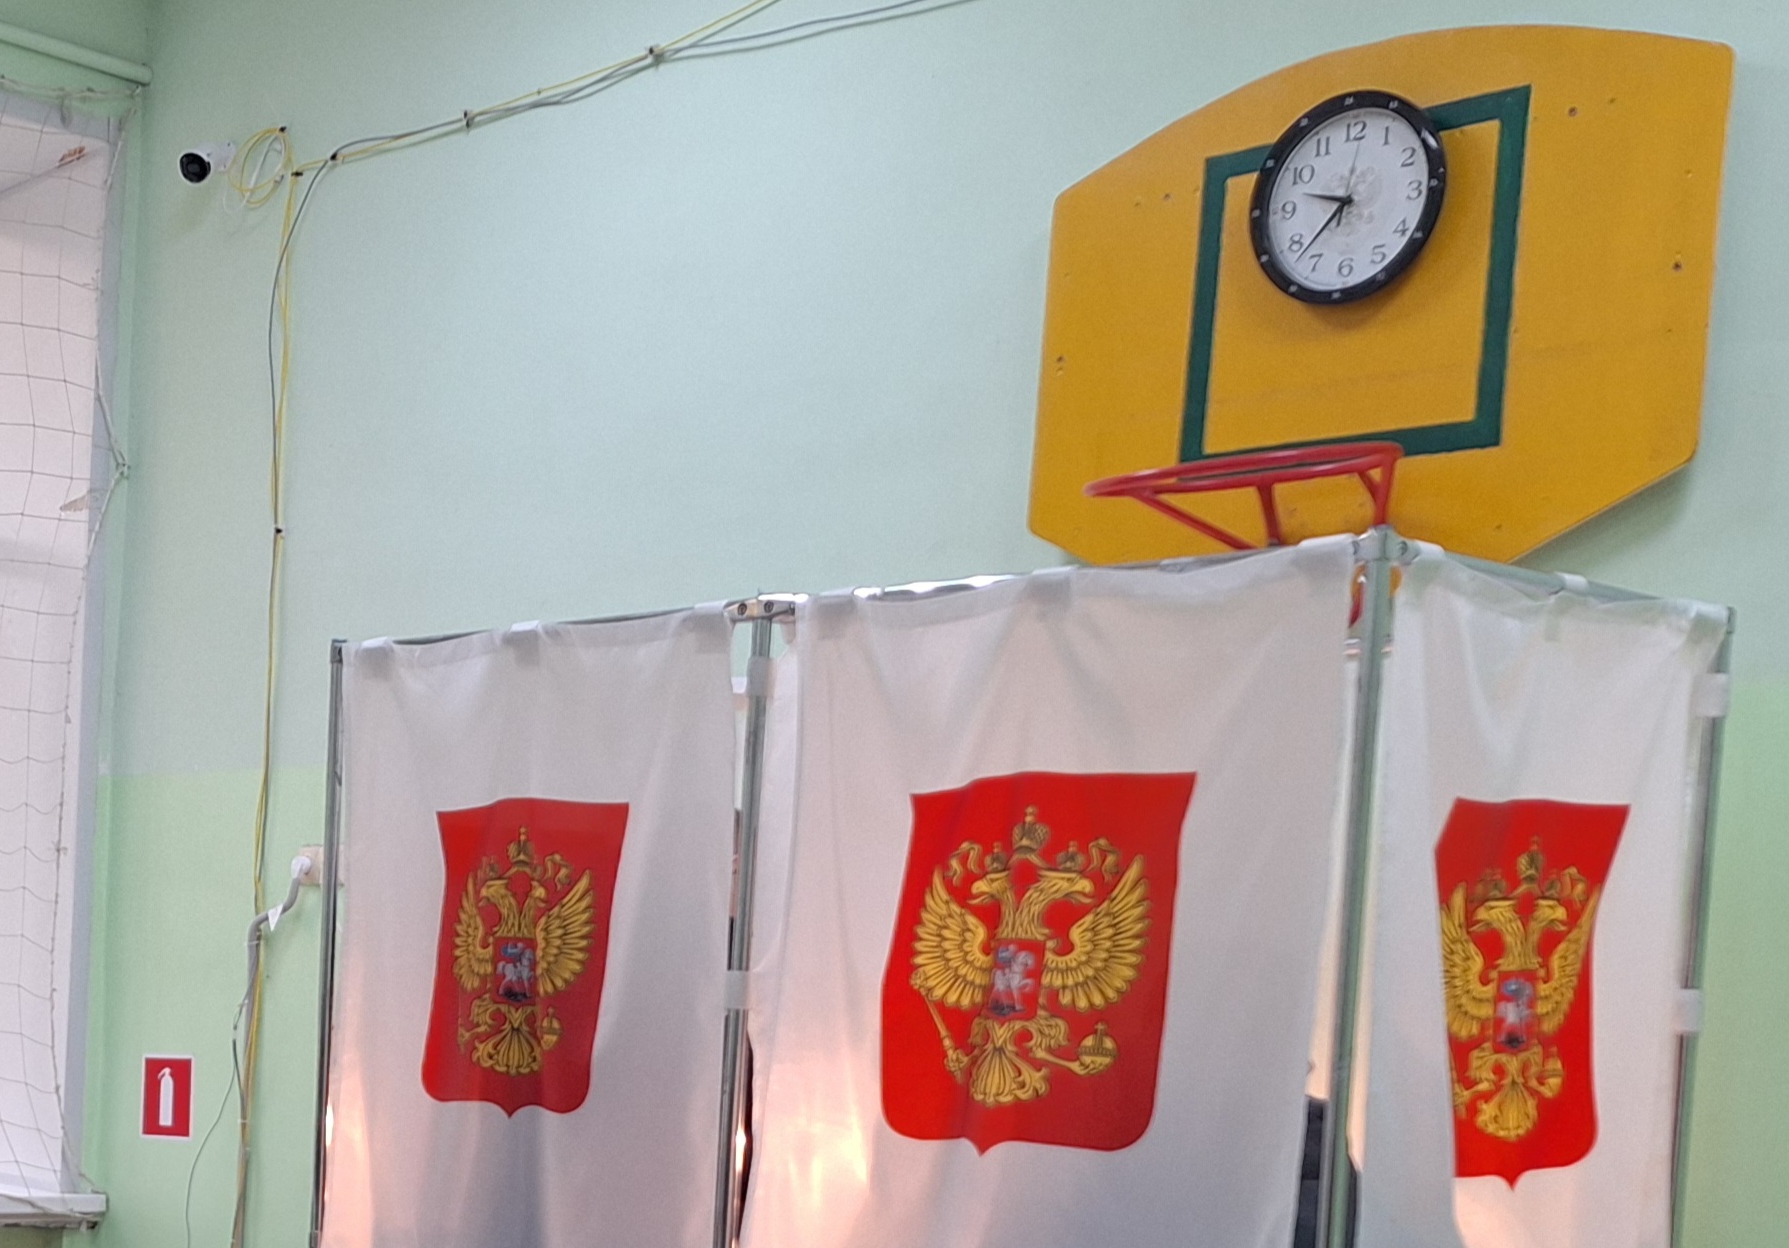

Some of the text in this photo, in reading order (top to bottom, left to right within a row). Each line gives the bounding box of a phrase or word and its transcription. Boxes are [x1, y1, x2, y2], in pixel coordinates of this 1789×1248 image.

[1344, 121, 1366, 142] 12
[1382, 126, 1390, 145] 1
[1314, 137, 1331, 157] 11
[1400, 147, 1416, 167] 2
[1291, 165, 1315, 185] 10
[1406, 180, 1422, 200] 3
[1281, 201, 1296, 219] 9
[1393, 217, 1409, 237] 4
[1288, 233, 1303, 252] 8
[1308, 254, 1323, 272] 7
[1371, 244, 1386, 264] 5
[1338, 258, 1353, 277] 6
